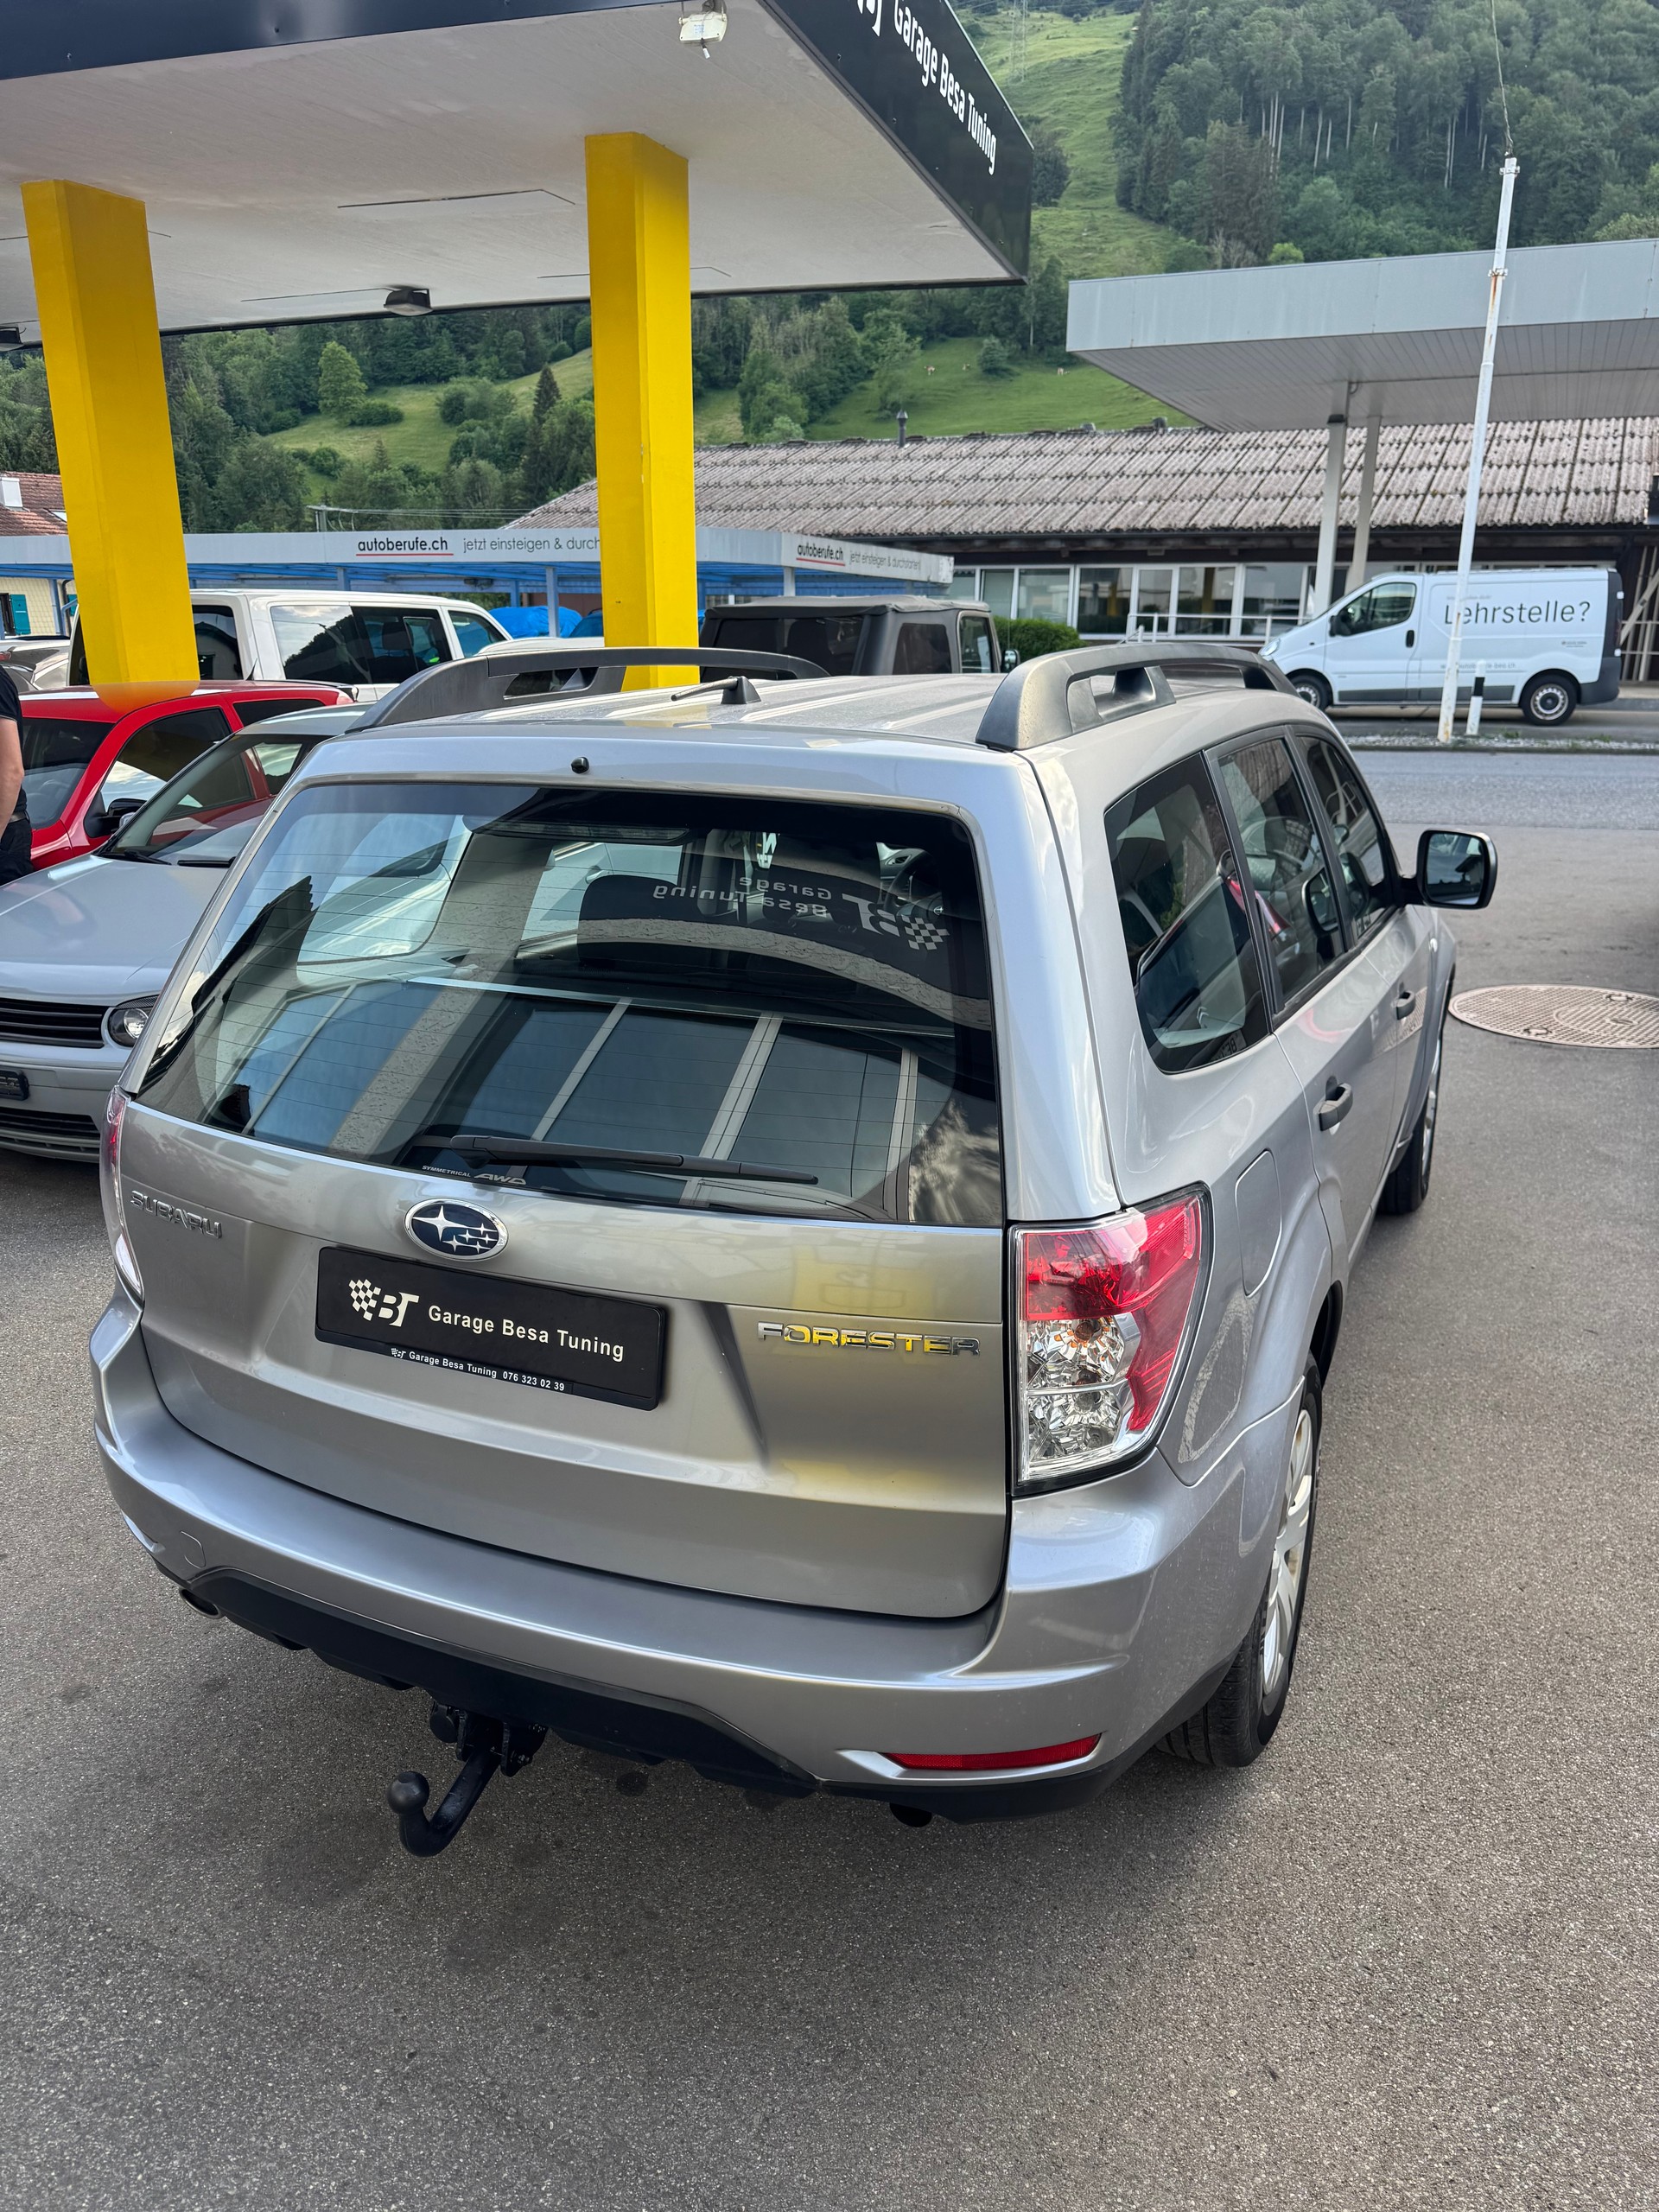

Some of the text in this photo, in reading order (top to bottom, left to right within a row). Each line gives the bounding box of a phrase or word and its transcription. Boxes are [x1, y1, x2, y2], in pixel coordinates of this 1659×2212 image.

[894, 0, 996, 175] Garage Besa Tuning
[358, 536, 448, 551] autoberufe.ch
[463, 537, 486, 553] jetzt
[490, 537, 550, 553] einsteigen
[554, 537, 563, 550] &
[797, 542, 844, 561] autoberufe.ch
[1444, 601, 1591, 625] Lehrstelle?
[423, 1165, 526, 1185] SYMMETRICAL AWD
[130, 1190, 223, 1239] SUBARU
[428, 1305, 495, 1334] Garage
[502, 1319, 549, 1344] Besa
[556, 1329, 624, 1363] Tuning
[757, 1321, 981, 1357] FORESTER
[409, 1351, 440, 1365] Garage
[442, 1358, 464, 1370] Besa
[467, 1363, 497, 1379] Tuning
[503, 1371, 518, 1382] 076
[521, 1375, 537, 1386] 323
[540, 1379, 551, 1389] 02
[554, 1382, 565, 1391] 39
